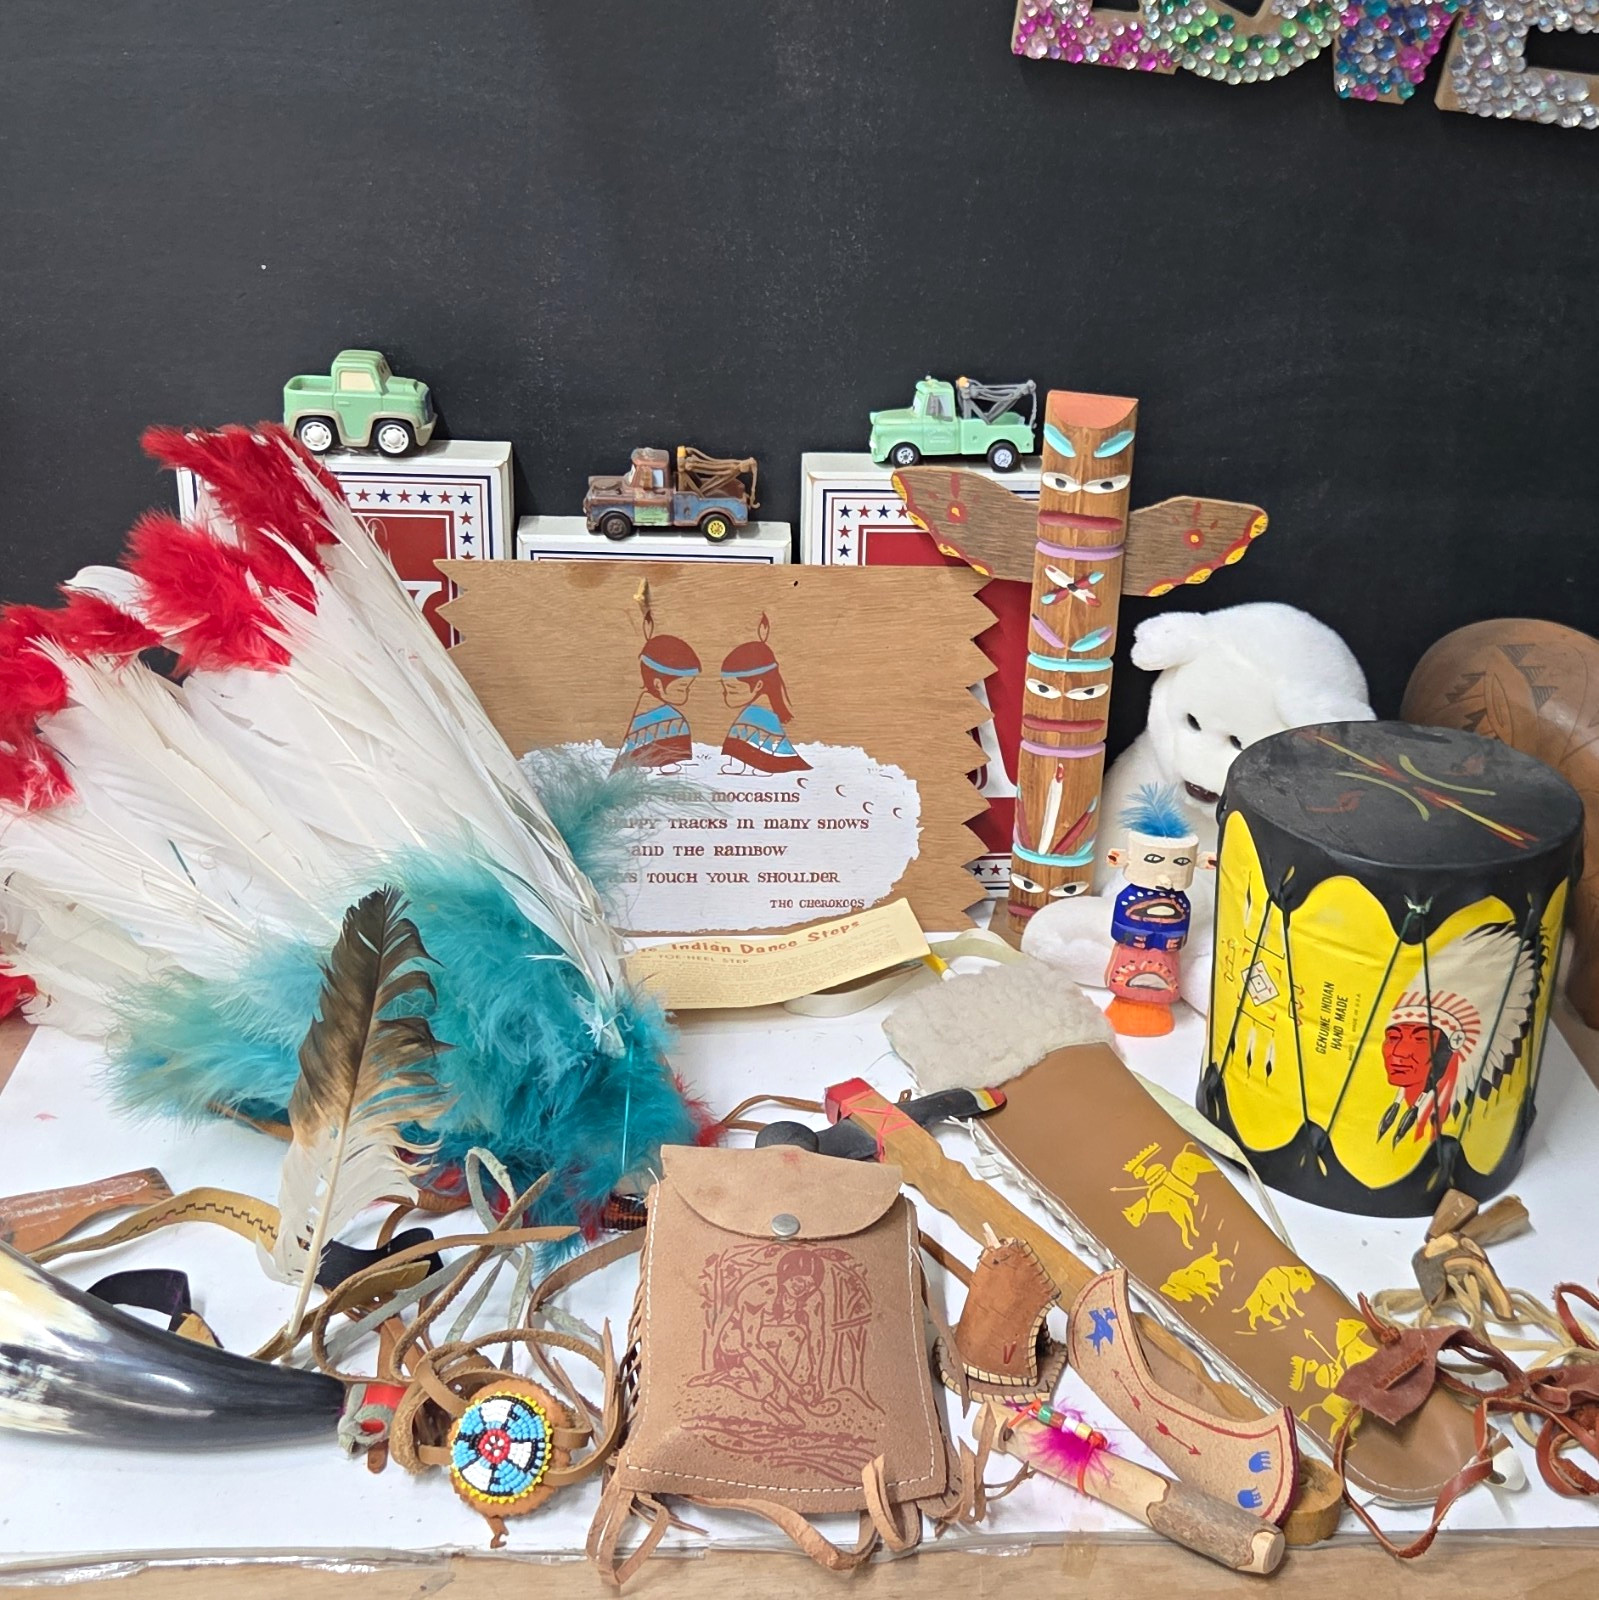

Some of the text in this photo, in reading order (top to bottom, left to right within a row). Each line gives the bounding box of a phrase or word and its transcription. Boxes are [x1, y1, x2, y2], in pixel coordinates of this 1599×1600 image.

[670, 942, 732, 954] Indian
[740, 939, 798, 955] Dance
[807, 919, 861, 943] Steps
[1315, 981, 1335, 1055] GENUINE INDIAN
[1330, 995, 1348, 1051] HAND MADE
